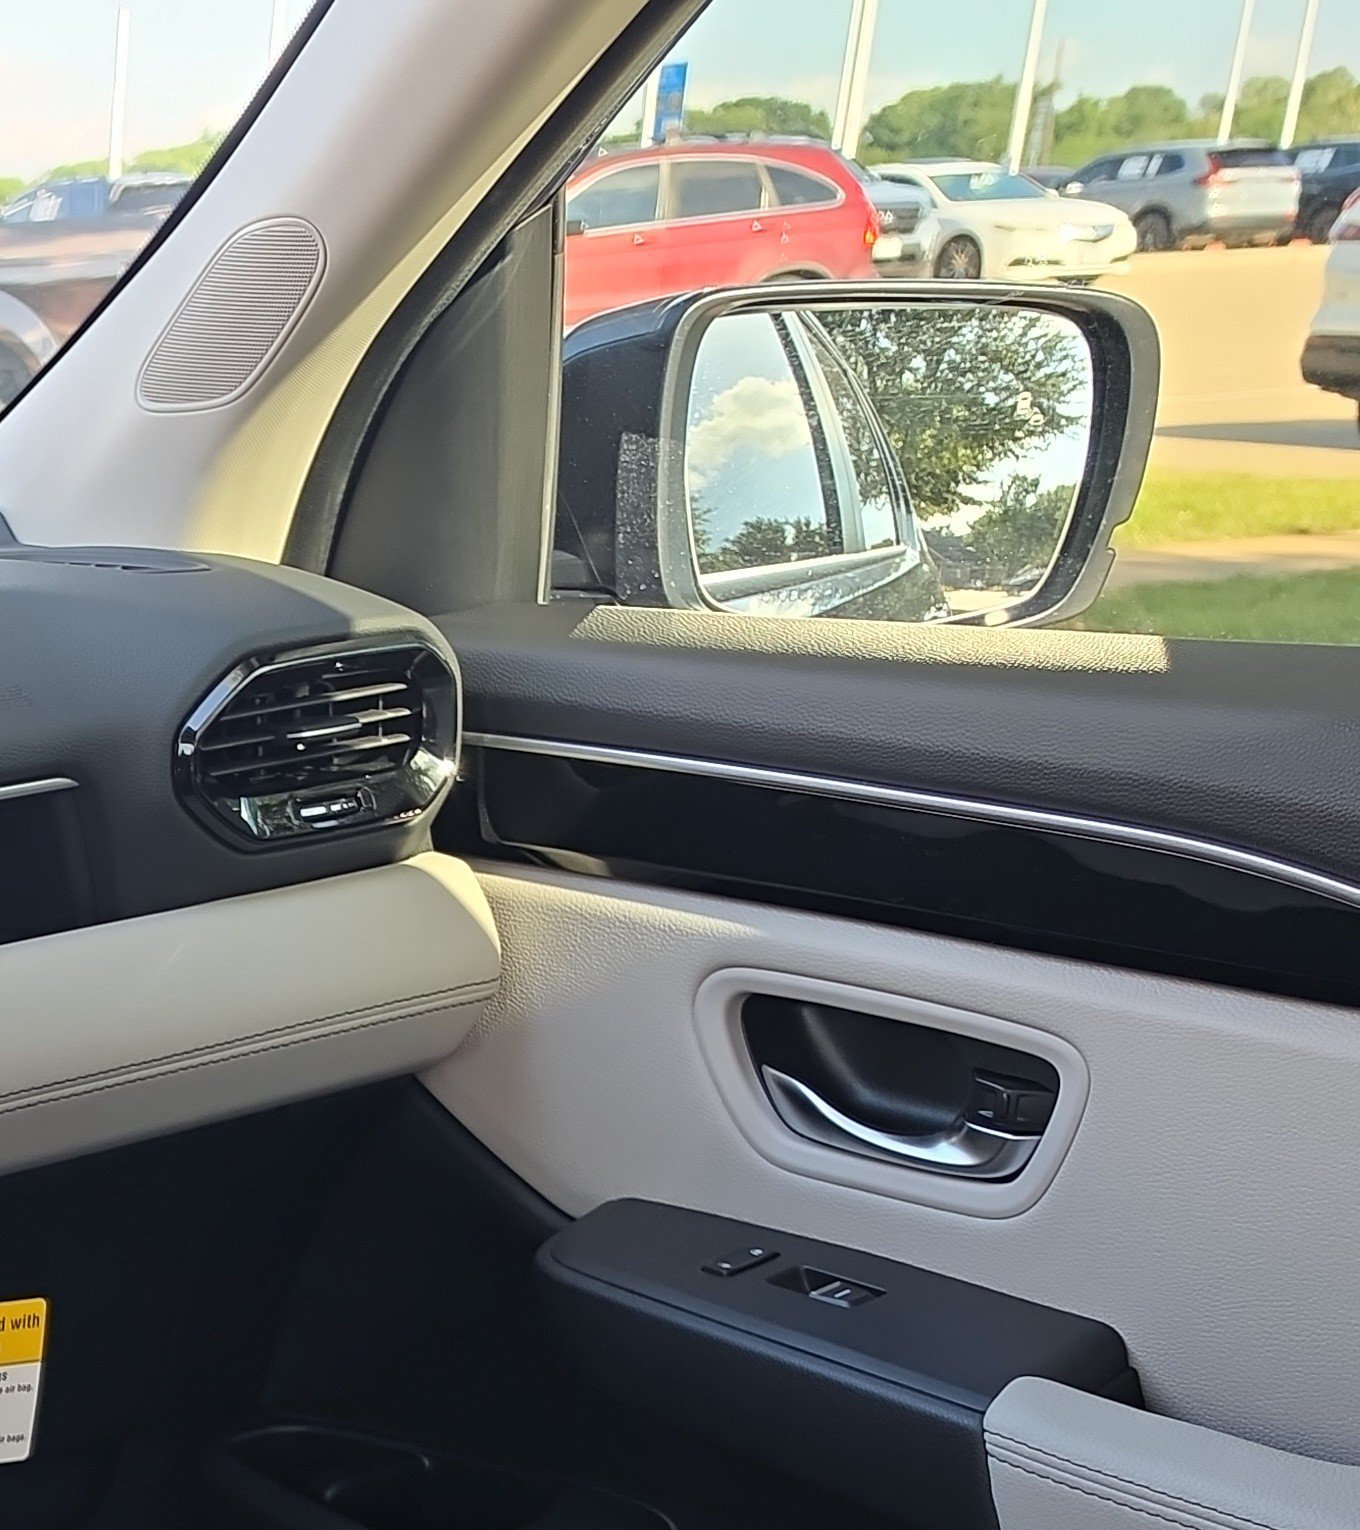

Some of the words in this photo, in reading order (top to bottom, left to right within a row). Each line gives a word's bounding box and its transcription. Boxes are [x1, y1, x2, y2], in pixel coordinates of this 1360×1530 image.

[10, 1313, 40, 1330] with
[5, 1384, 15, 1393] air
[17, 1383, 33, 1393] bag.
